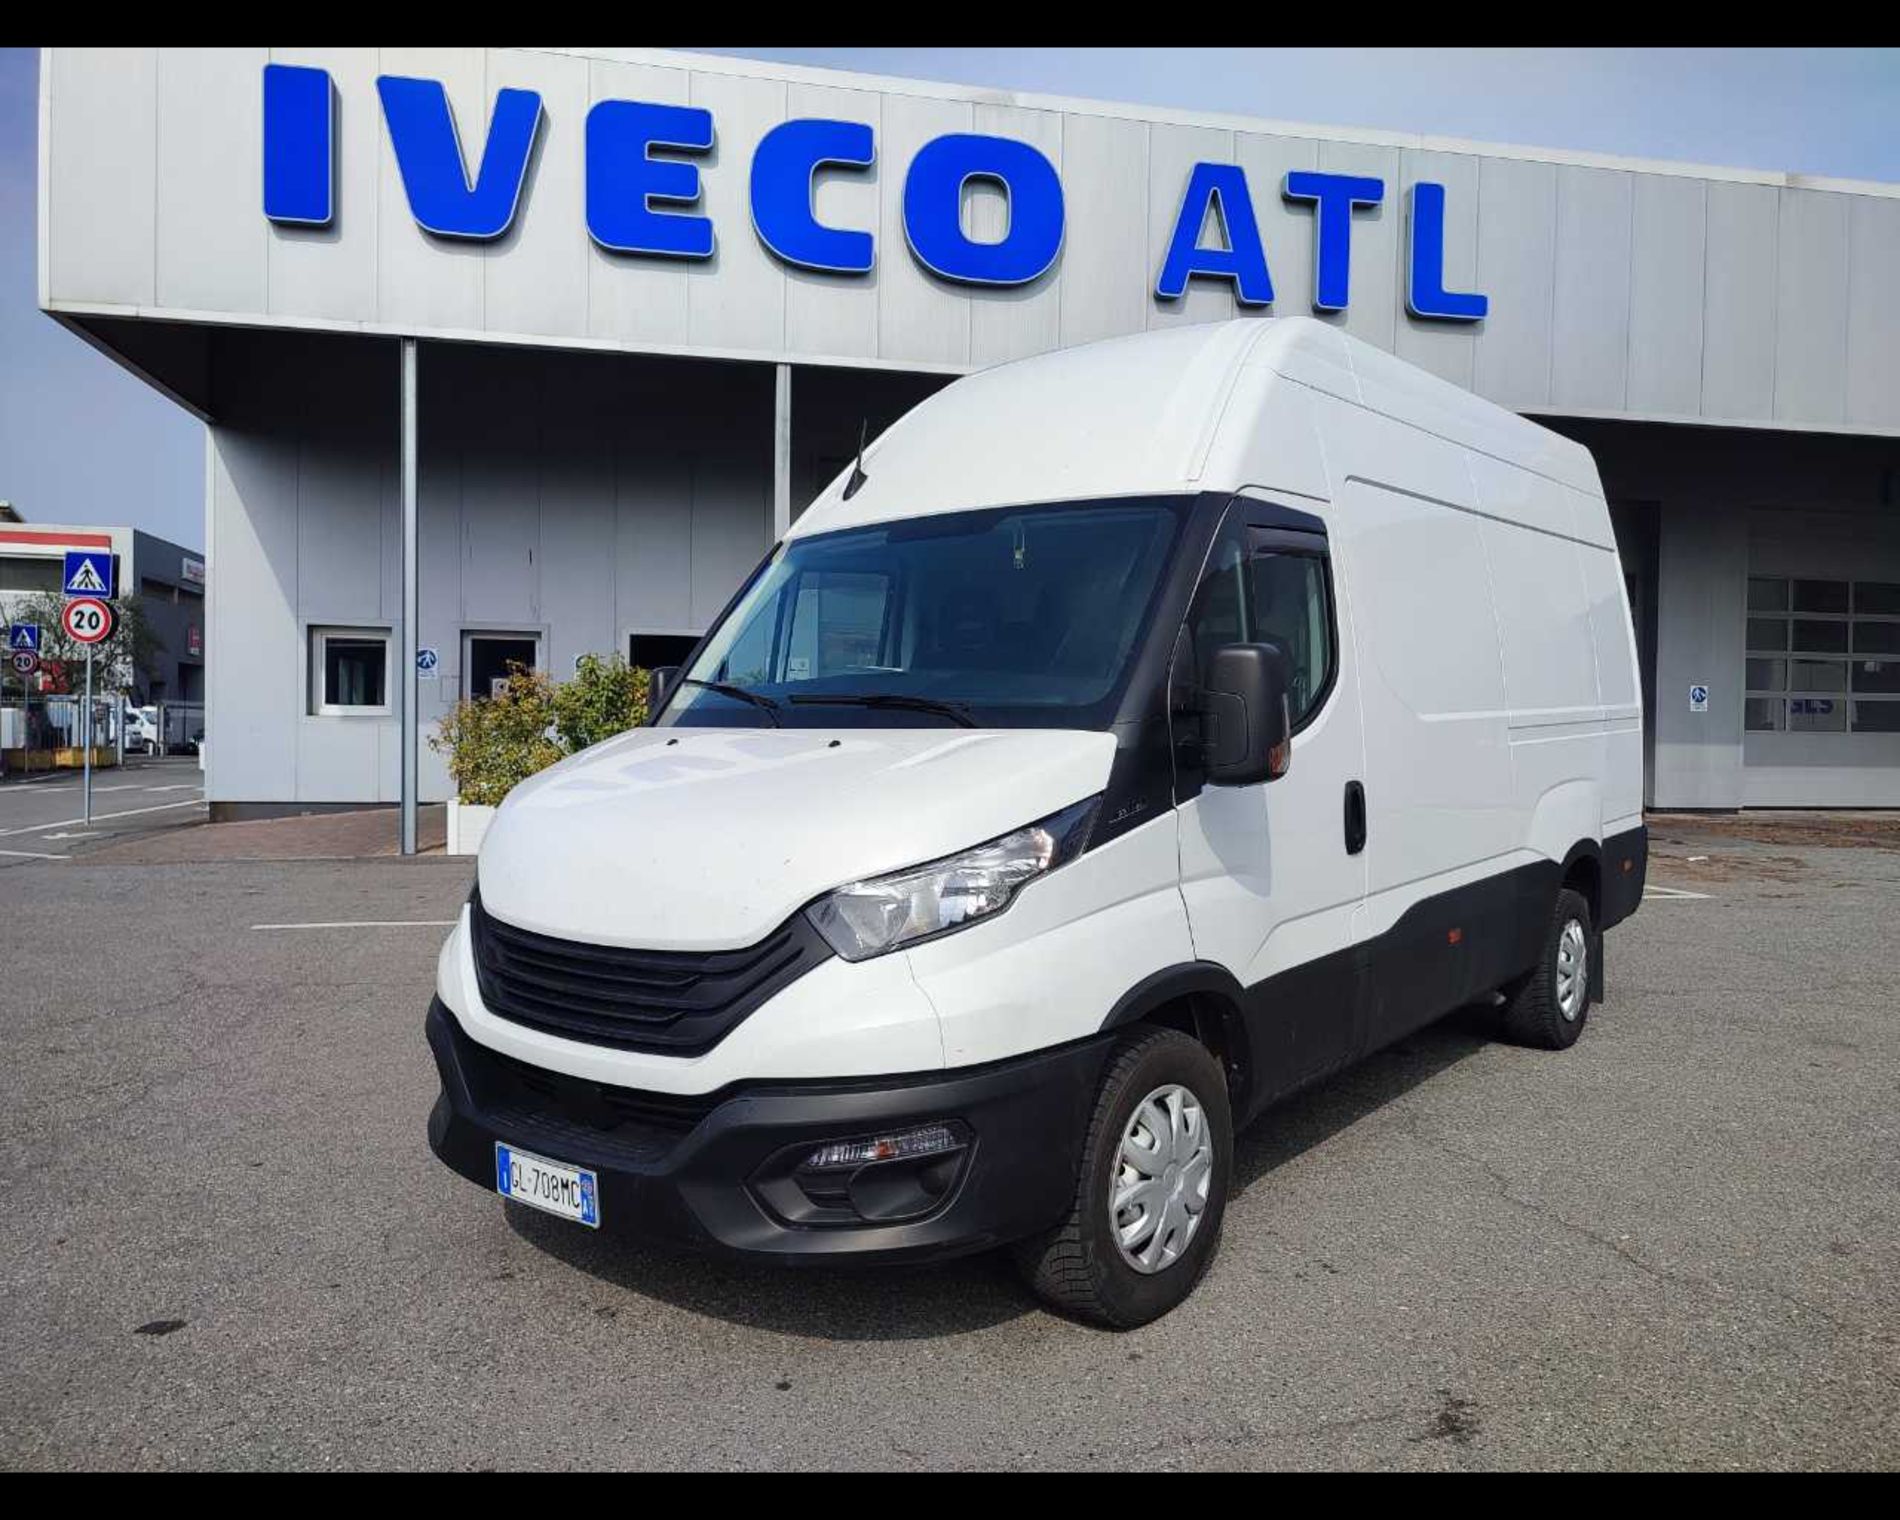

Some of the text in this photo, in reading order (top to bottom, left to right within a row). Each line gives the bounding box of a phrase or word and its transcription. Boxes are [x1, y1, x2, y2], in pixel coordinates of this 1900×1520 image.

[262, 63, 1488, 321] IVECO ATL
[74, 610, 100, 630] 20
[16, 657, 31, 667] 20
